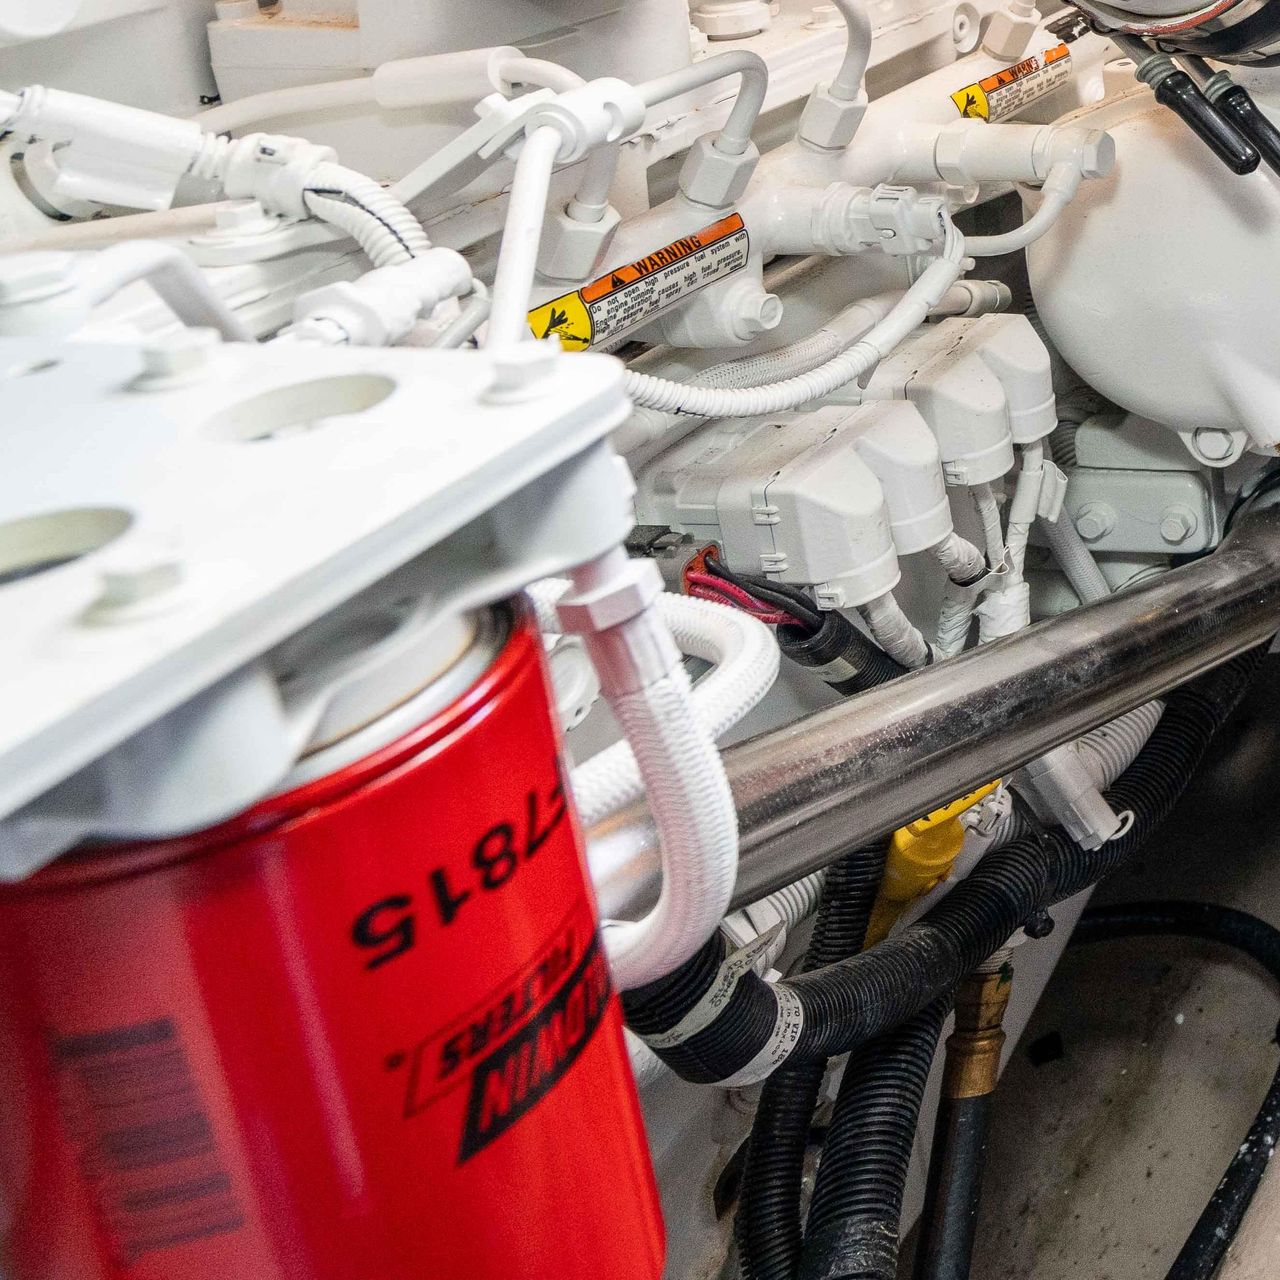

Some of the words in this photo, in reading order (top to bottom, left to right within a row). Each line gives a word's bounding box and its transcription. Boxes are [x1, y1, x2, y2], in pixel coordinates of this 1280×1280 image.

[632, 235, 702, 276] WARNING
[591, 304, 601, 314] Do
[607, 295, 619, 306] not
[623, 286, 640, 298] open
[645, 275, 659, 289] high
[663, 260, 689, 280] pressure
[694, 251, 706, 264] fuel
[710, 241, 731, 256] system
[734, 233, 746, 244] with
[596, 312, 617, 327] Engine
[623, 296, 652, 314] operation
[657, 281, 679, 296] causes
[607, 300, 628, 315] engine
[616, 307, 643, 325] pressure
[790, 1023, 800, 1042] VIP
